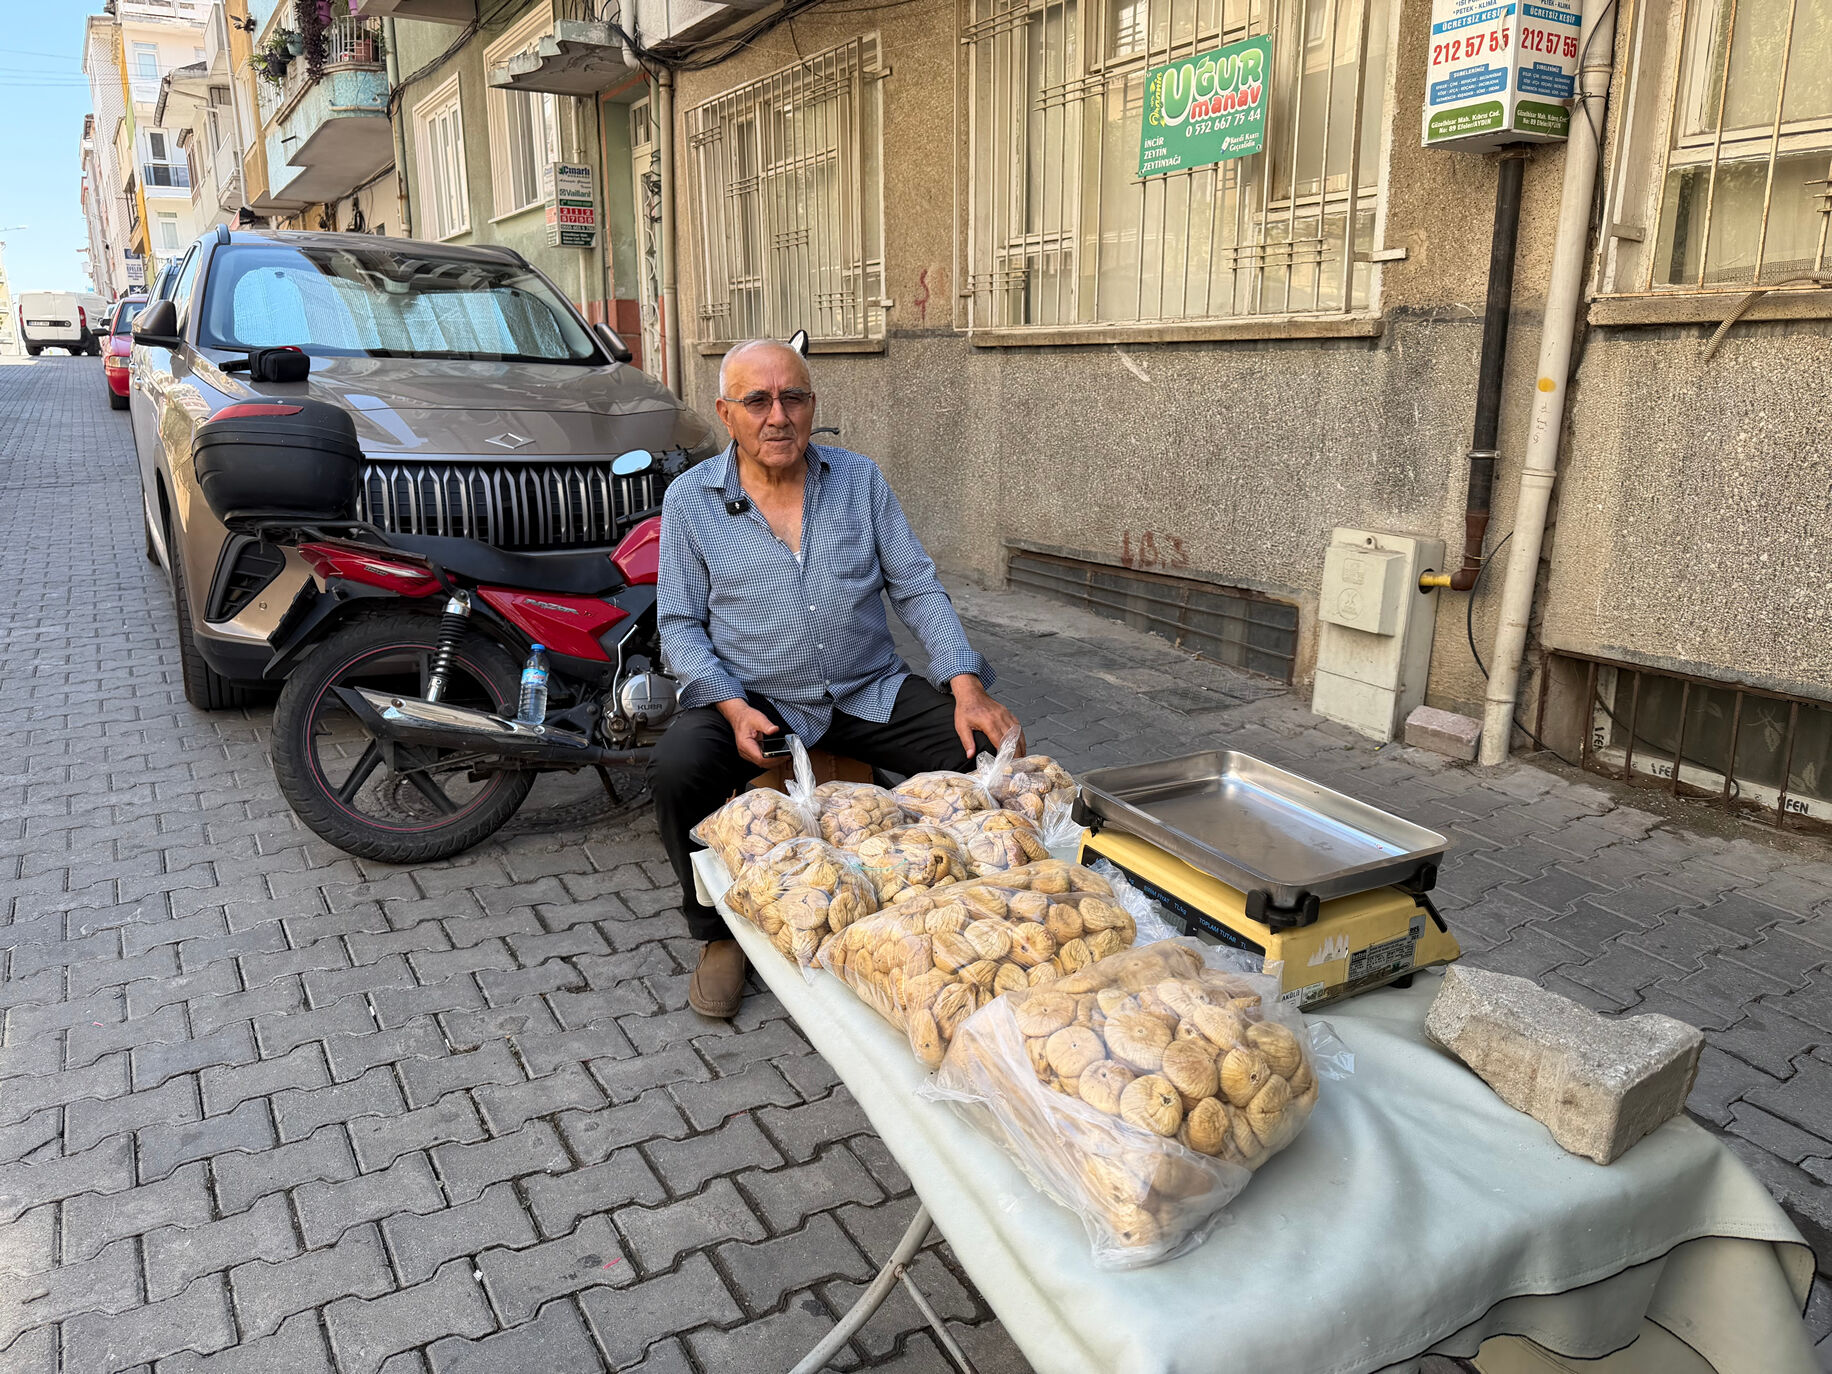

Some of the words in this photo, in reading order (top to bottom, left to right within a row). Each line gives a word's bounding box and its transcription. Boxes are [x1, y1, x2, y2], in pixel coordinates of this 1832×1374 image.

[1442, 14, 1480, 31] ÜCRETSİZ
[1530, 6, 1558, 20] ÜCRETSİZ
[1559, 13, 1576, 24] KEŞİF
[1433, 40, 1461, 66] 212
[1465, 34, 1485, 58] 57
[1489, 28, 1510, 52] 55
[1521, 27, 1544, 52] 212
[1546, 32, 1561, 55] 57
[1563, 36, 1578, 58] 55
[1161, 48, 1264, 126] UĞUR
[1189, 84, 1262, 123] manav
[1186, 126, 1193, 137] 0
[1195, 121, 1212, 136] 532
[1214, 116, 1232, 130] 667
[1234, 112, 1246, 126] 75
[1248, 108, 1261, 121] 44
[1144, 136, 1164, 148] İNCİR
[1143, 155, 1181, 171] ZEYTİNYAĞI
[1144, 147, 1167, 160] ZEYTİN
[566, 190, 591, 198] Vaillant
[1200, 917, 1220, 933] TOPLAM
[1220, 928, 1237, 944] TUTAR
